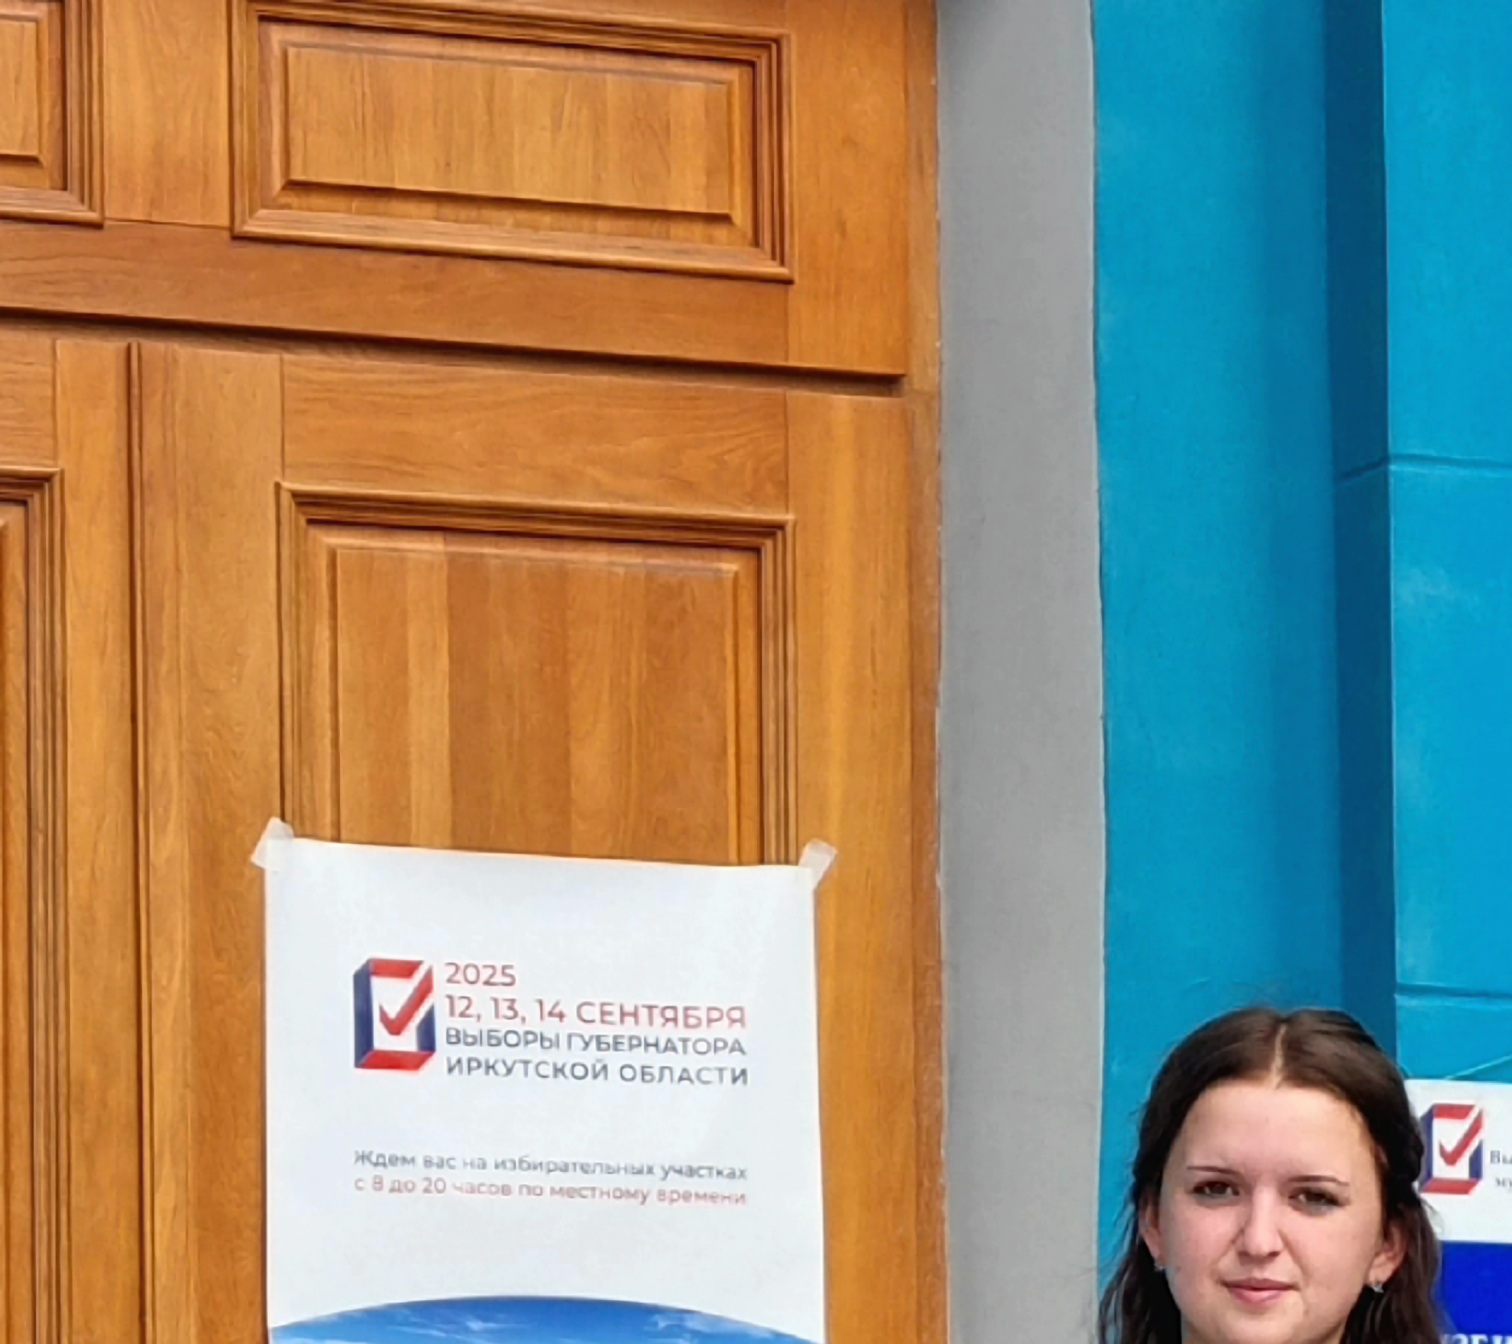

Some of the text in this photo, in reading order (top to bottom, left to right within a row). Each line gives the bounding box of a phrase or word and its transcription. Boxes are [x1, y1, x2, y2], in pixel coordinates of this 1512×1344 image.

[444, 961, 517, 987] 2025
[445, 994, 747, 1030] 12, 13, 14 СЕНТЯБРЯ
[445, 1026, 747, 1056] ВЫБОРЫ ГУБЕРНАТОРА
[446, 1055, 749, 1086] ИРКУТСКОЙ ОБЛАСТИ
[354, 1149, 748, 1181] Ждем вас на избирательных участках
[354, 1178, 365, 1192] с
[388, 1179, 416, 1195] до
[422, 1176, 447, 1195] 20
[453, 1182, 513, 1197] часов
[518, 1184, 544, 1197] по
[549, 1185, 651, 1206] местному
[656, 1187, 747, 1206] времени
